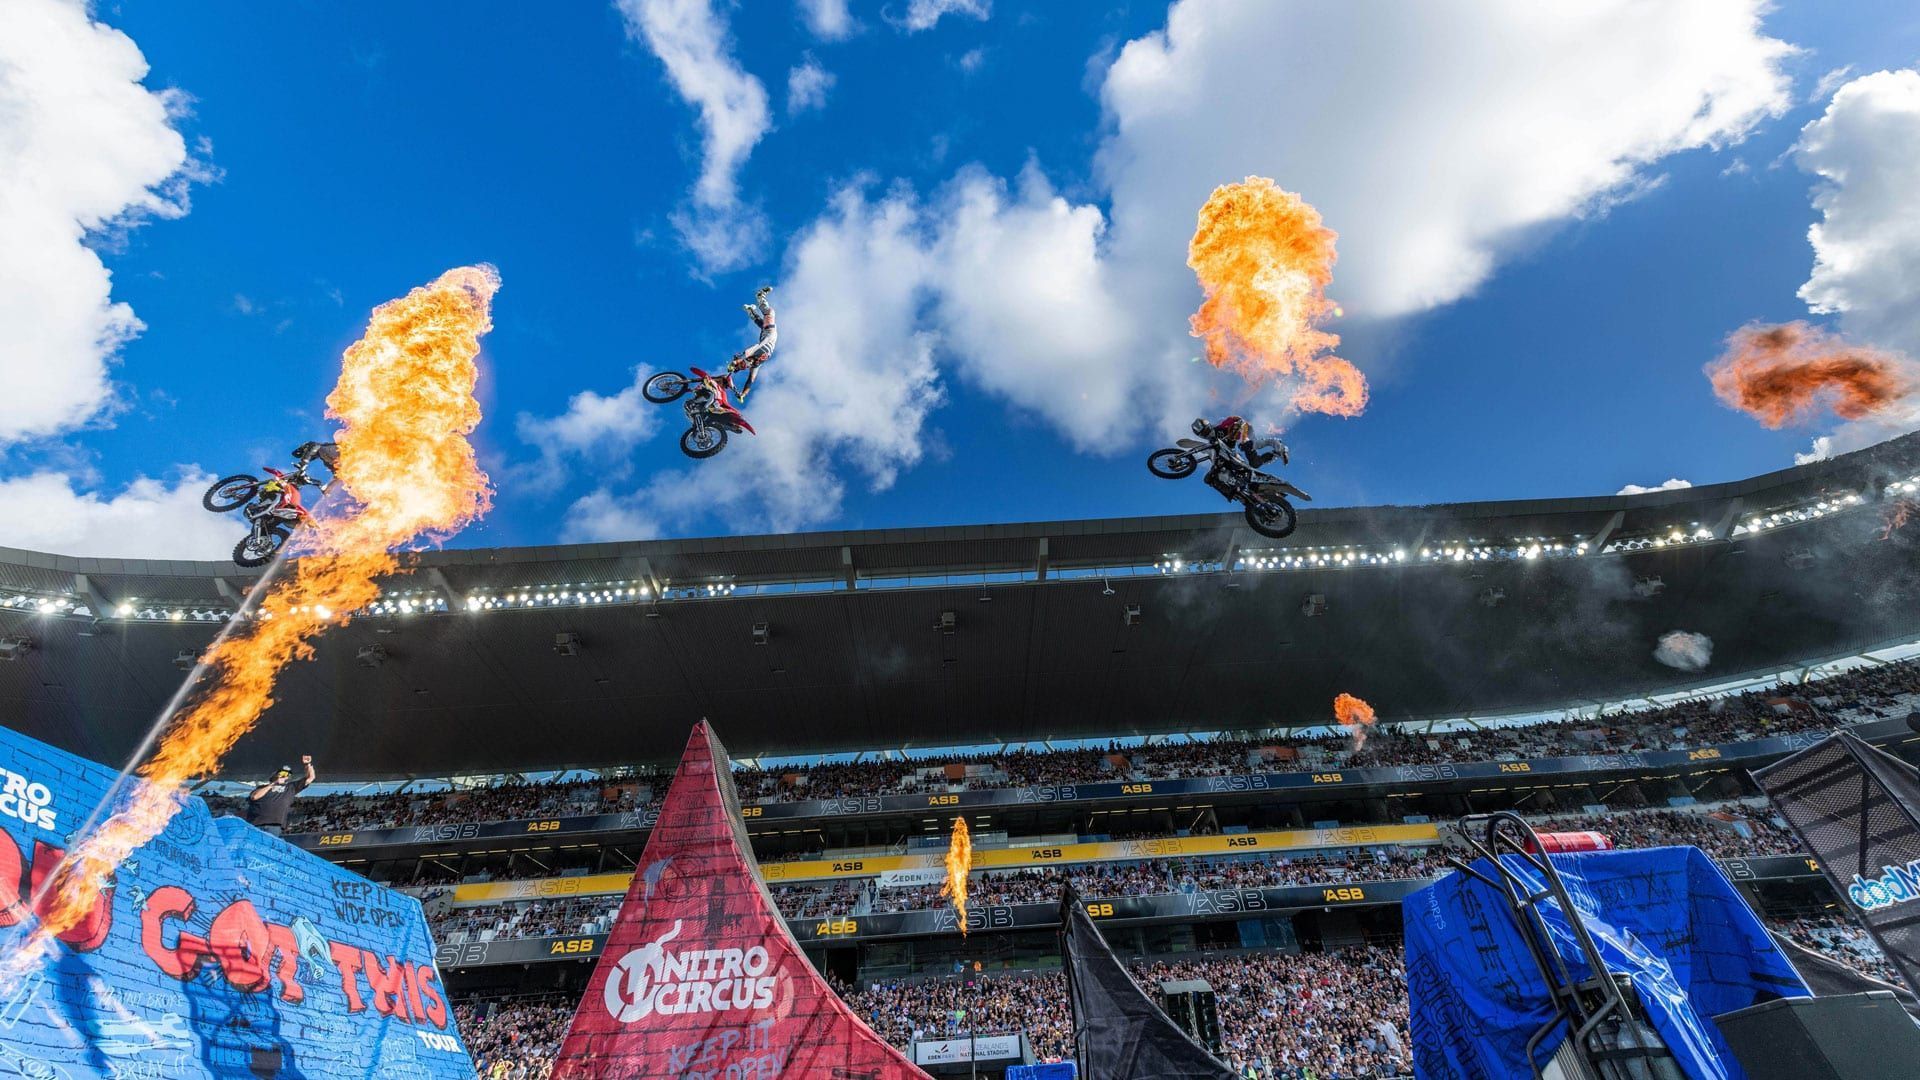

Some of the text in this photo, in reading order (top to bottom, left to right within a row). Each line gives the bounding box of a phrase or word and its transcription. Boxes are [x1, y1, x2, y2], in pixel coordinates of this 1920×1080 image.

[1398, 764, 1459, 781] ASB
[1499, 763, 1531, 772] ASB
[1207, 774, 1269, 791] ASB
[1312, 773, 1343, 783] ASB
[1016, 785, 1077, 803] ASB
[1121, 784, 1152, 794] ASB
[820, 797, 882, 816] ASB
[928, 796, 960, 806] ASB
[527, 820, 561, 832] ASB
[620, 811, 659, 829] AS
[319, 834, 354, 846] ASB
[414, 823, 481, 843] ASB
[1316, 828, 1377, 846] ASB
[1123, 839, 1183, 857] ASB
[1227, 837, 1258, 847] ASB
[1032, 850, 1063, 860] ASB
[832, 862, 863, 873] ASB
[518, 877, 580, 897] ASB
[899, 874, 922, 883] EDEN
[331, 876, 390, 908] KEEP IT
[1323, 887, 1365, 901] ASB
[1186, 889, 1267, 915] ASB
[331, 899, 405, 928] WIDE OPEN
[816, 920, 858, 936] ASB
[551, 939, 594, 954] ASB
[141, 885, 304, 1003] GOT
[330, 941, 448, 1030] THIS
[658, 945, 769, 982] NITRO
[651, 976, 777, 1014] CIRCUS
[416, 1030, 463, 1053] TOUR
[669, 1028, 739, 1075] KEEP
[749, 1017, 775, 1051] IT
